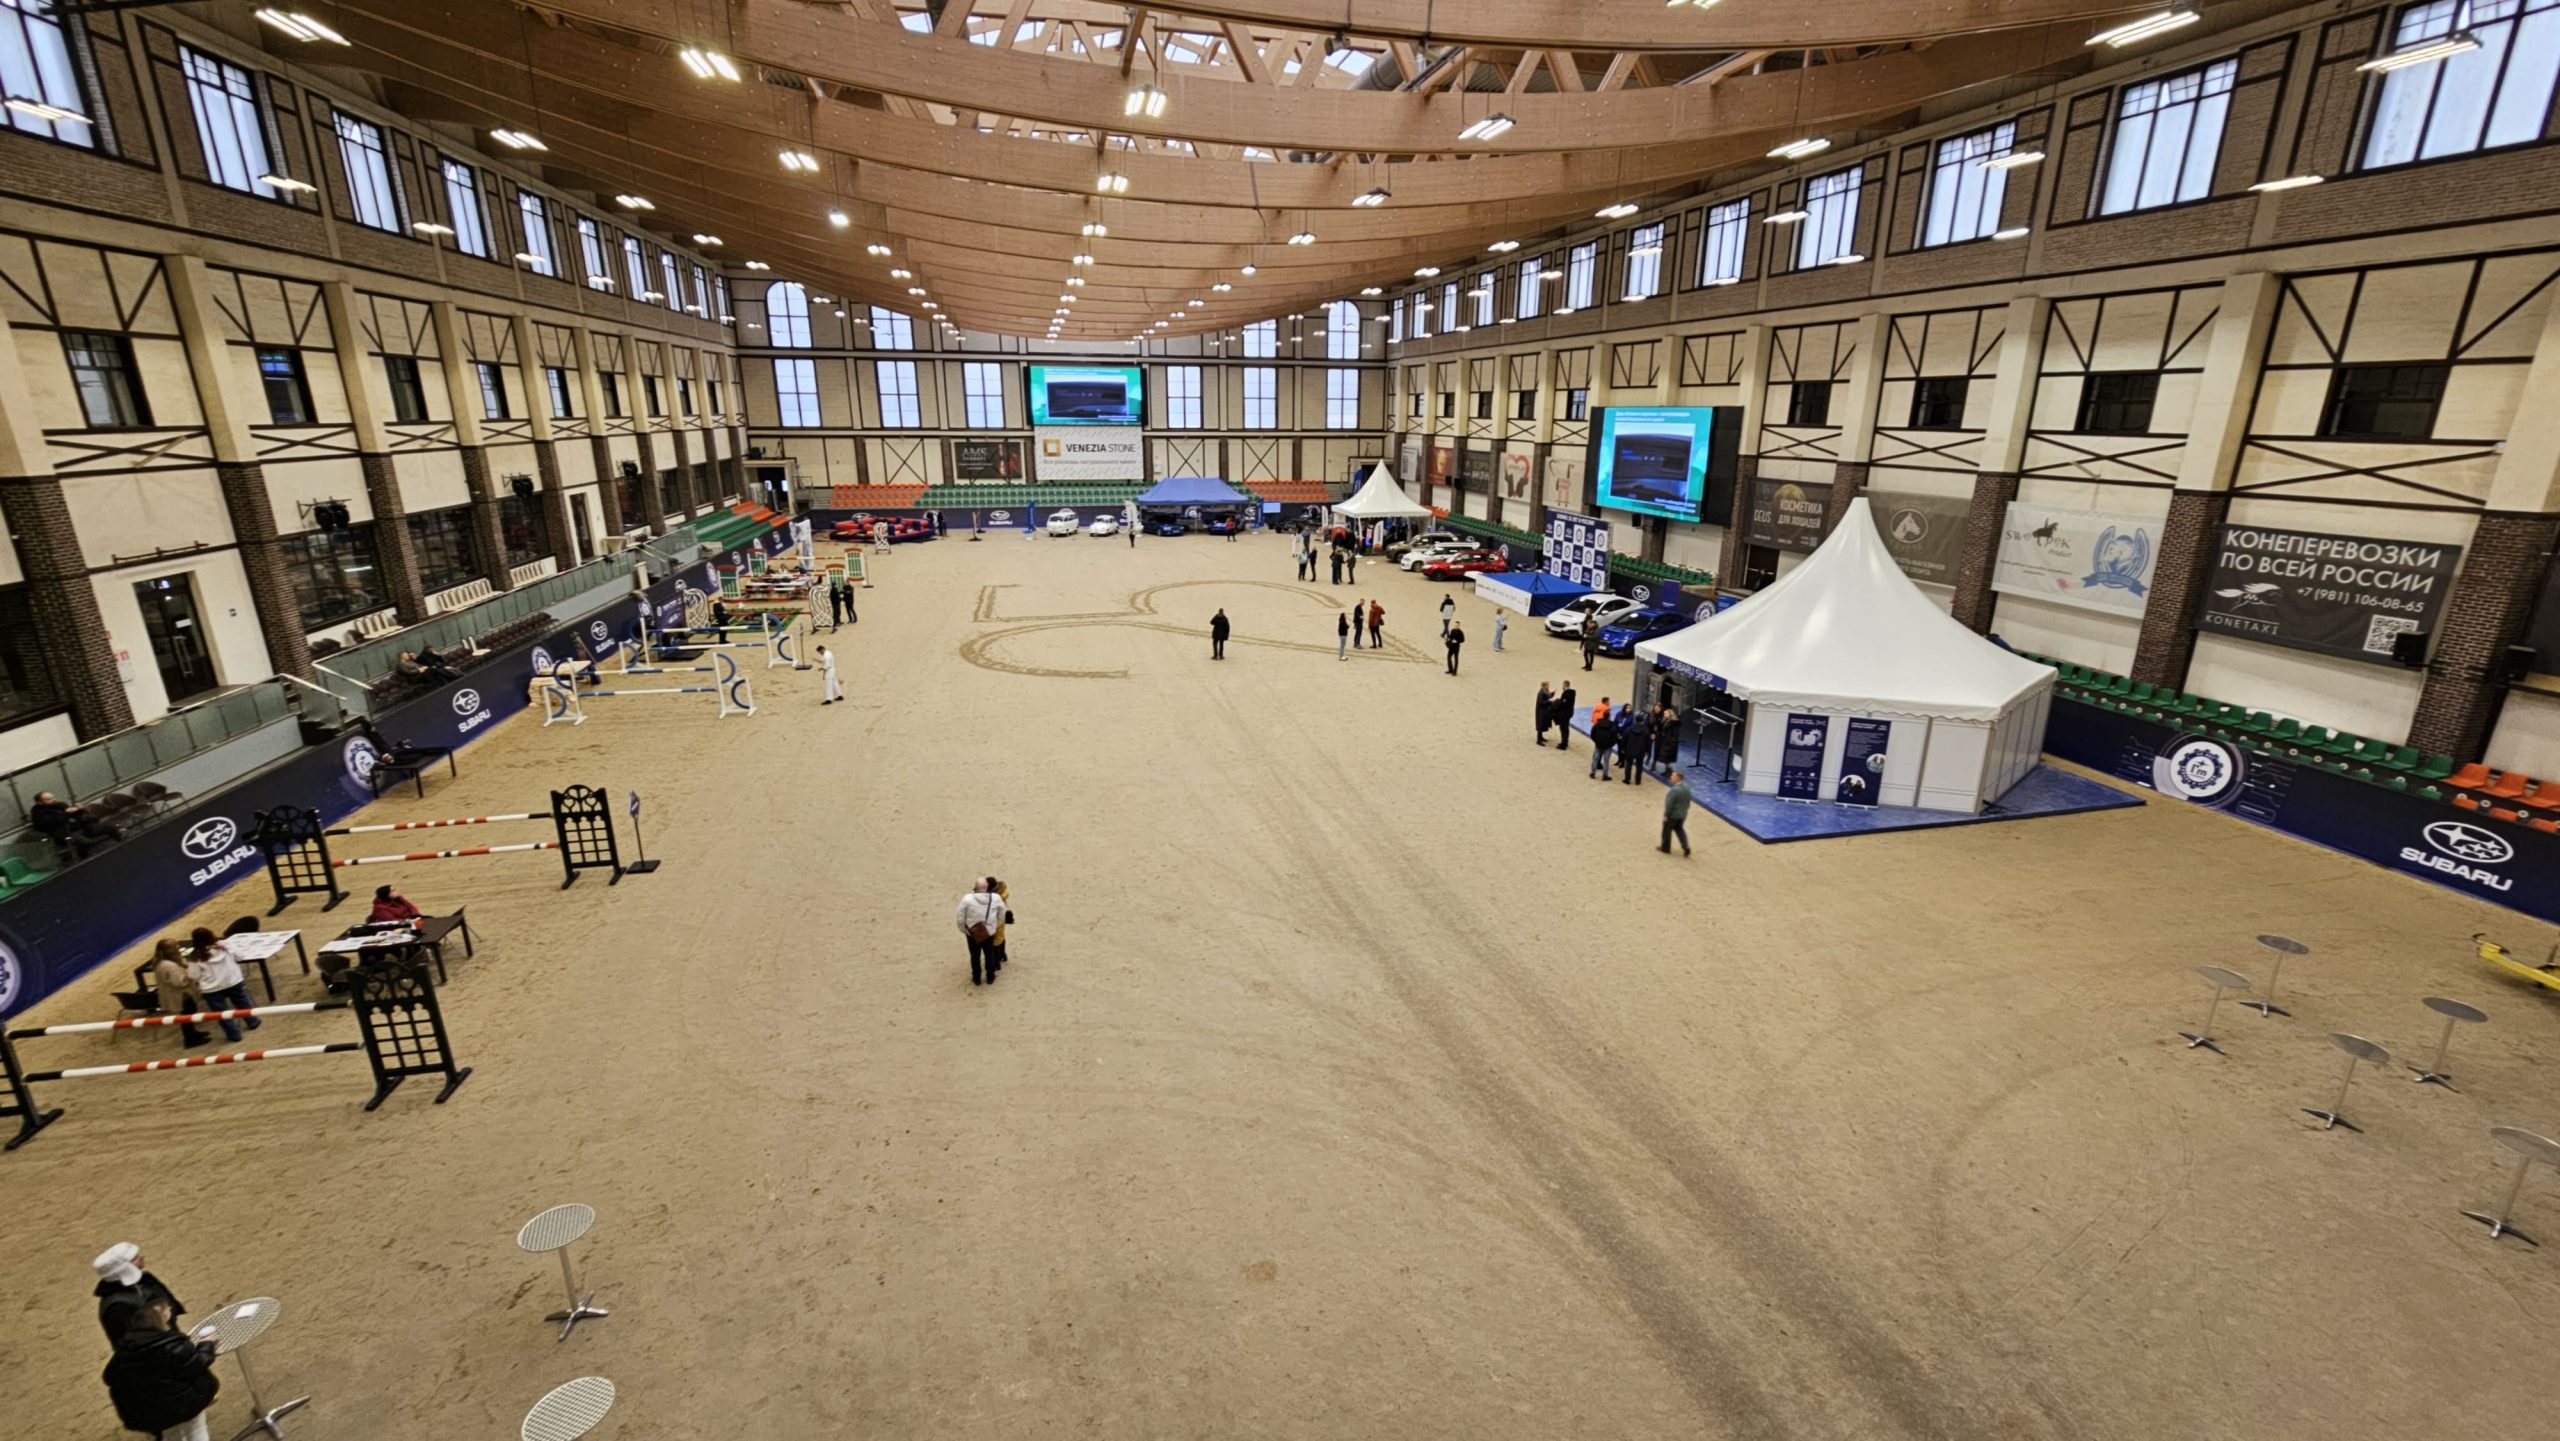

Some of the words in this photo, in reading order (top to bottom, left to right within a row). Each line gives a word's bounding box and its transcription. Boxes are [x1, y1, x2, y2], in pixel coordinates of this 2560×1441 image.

[1066, 444, 1106, 452] VENEZIA
[1108, 444, 1136, 452] STONE
[1780, 500, 1823, 515] КОСМЕТИКА
[2226, 529, 2441, 568] КОНЕПЕРЕВОЗКИ
[2220, 552, 2253, 571] ПО
[2258, 556, 2318, 579] ВСЕЙ
[2321, 564, 2435, 593] РОССИИ
[2297, 586, 2312, 597] +7
[2314, 588, 2350, 605] (981)
[2354, 593, 2425, 613] 106-08-65
[2205, 614, 2279, 635] KONETAXI
[1670, 659, 1695, 677] SUBARU
[1695, 668, 1713, 682] SHOP
[458, 709, 492, 733] SUBARU
[190, 845, 257, 886] SUBARU
[2400, 847, 2513, 891] SUBARU
